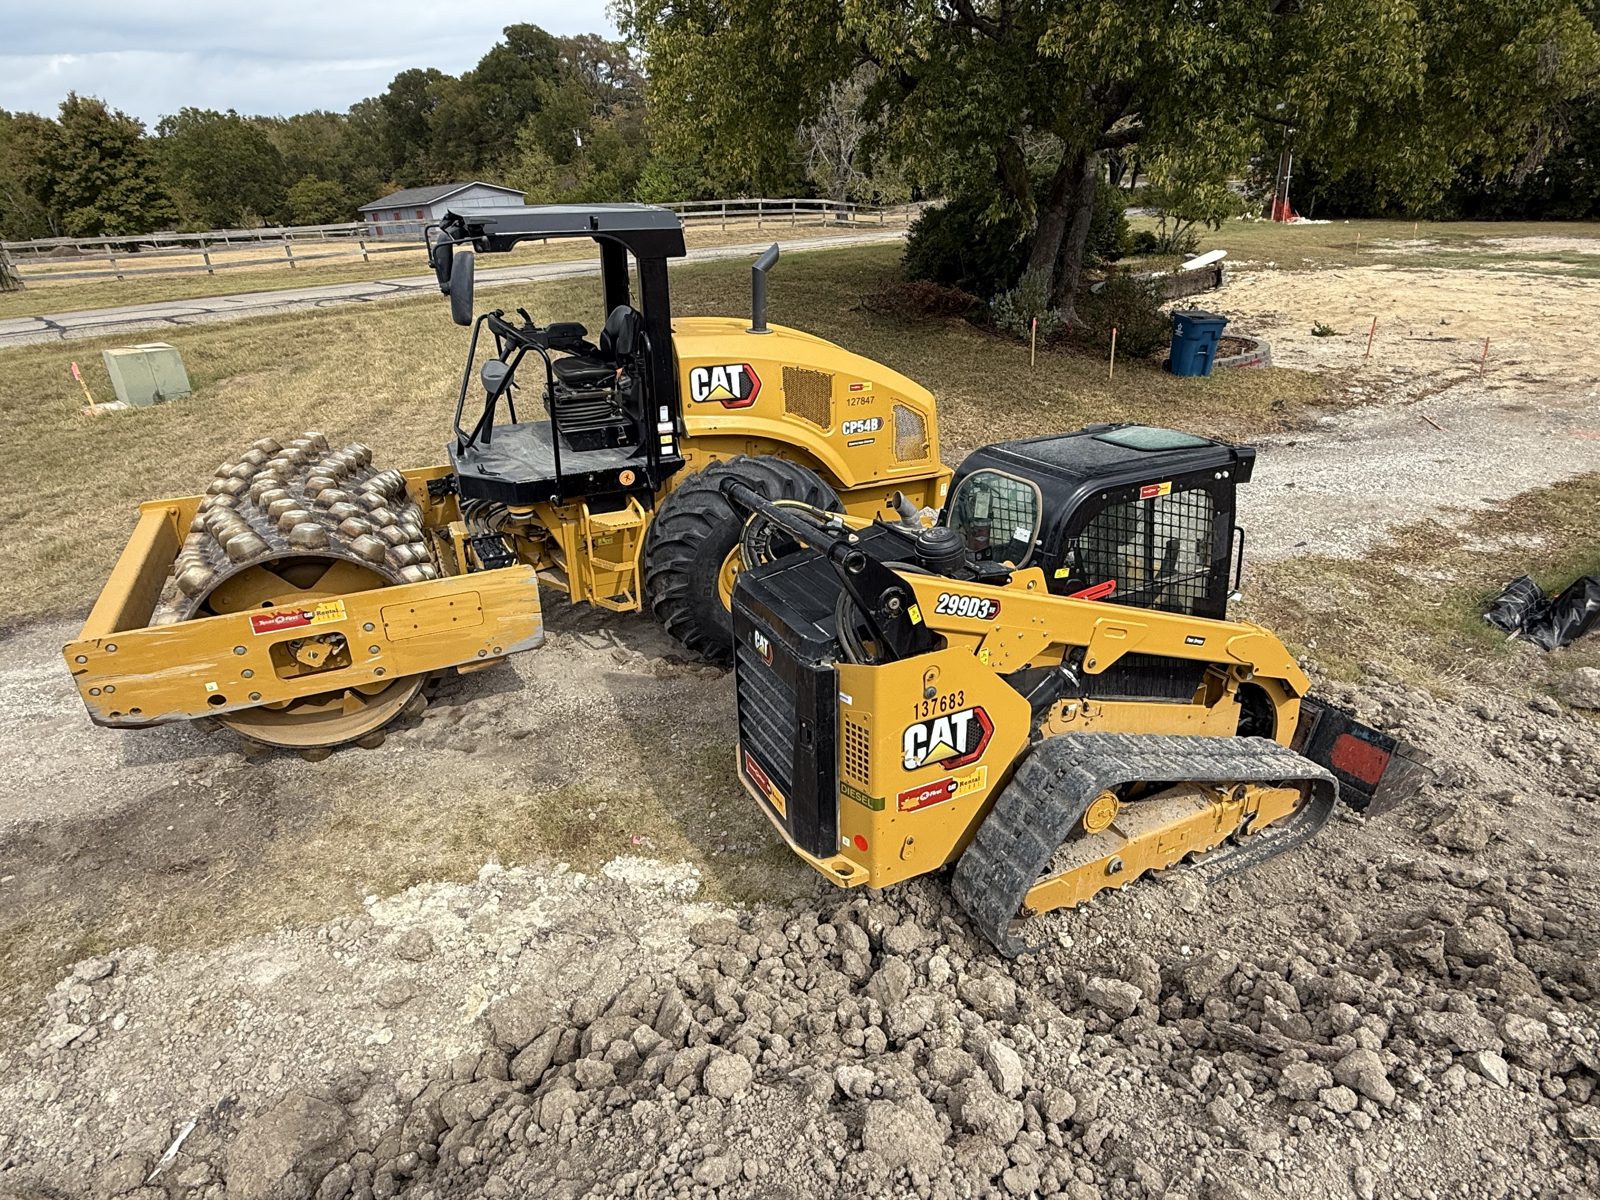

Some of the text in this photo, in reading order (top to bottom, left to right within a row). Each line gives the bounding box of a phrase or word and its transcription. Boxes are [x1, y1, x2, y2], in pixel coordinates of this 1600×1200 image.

[690, 365, 744, 402] CAT
[846, 396, 875, 406] 127847
[842, 418, 878, 435] CP54B
[316, 608, 339, 617] Rental
[935, 593, 990, 618] 299D3
[754, 630, 769, 657] CAT
[914, 690, 964, 720] 137683
[904, 708, 973, 770] CAT
[960, 776, 981, 788] Rental
[841, 784, 874, 809] DIESEL
